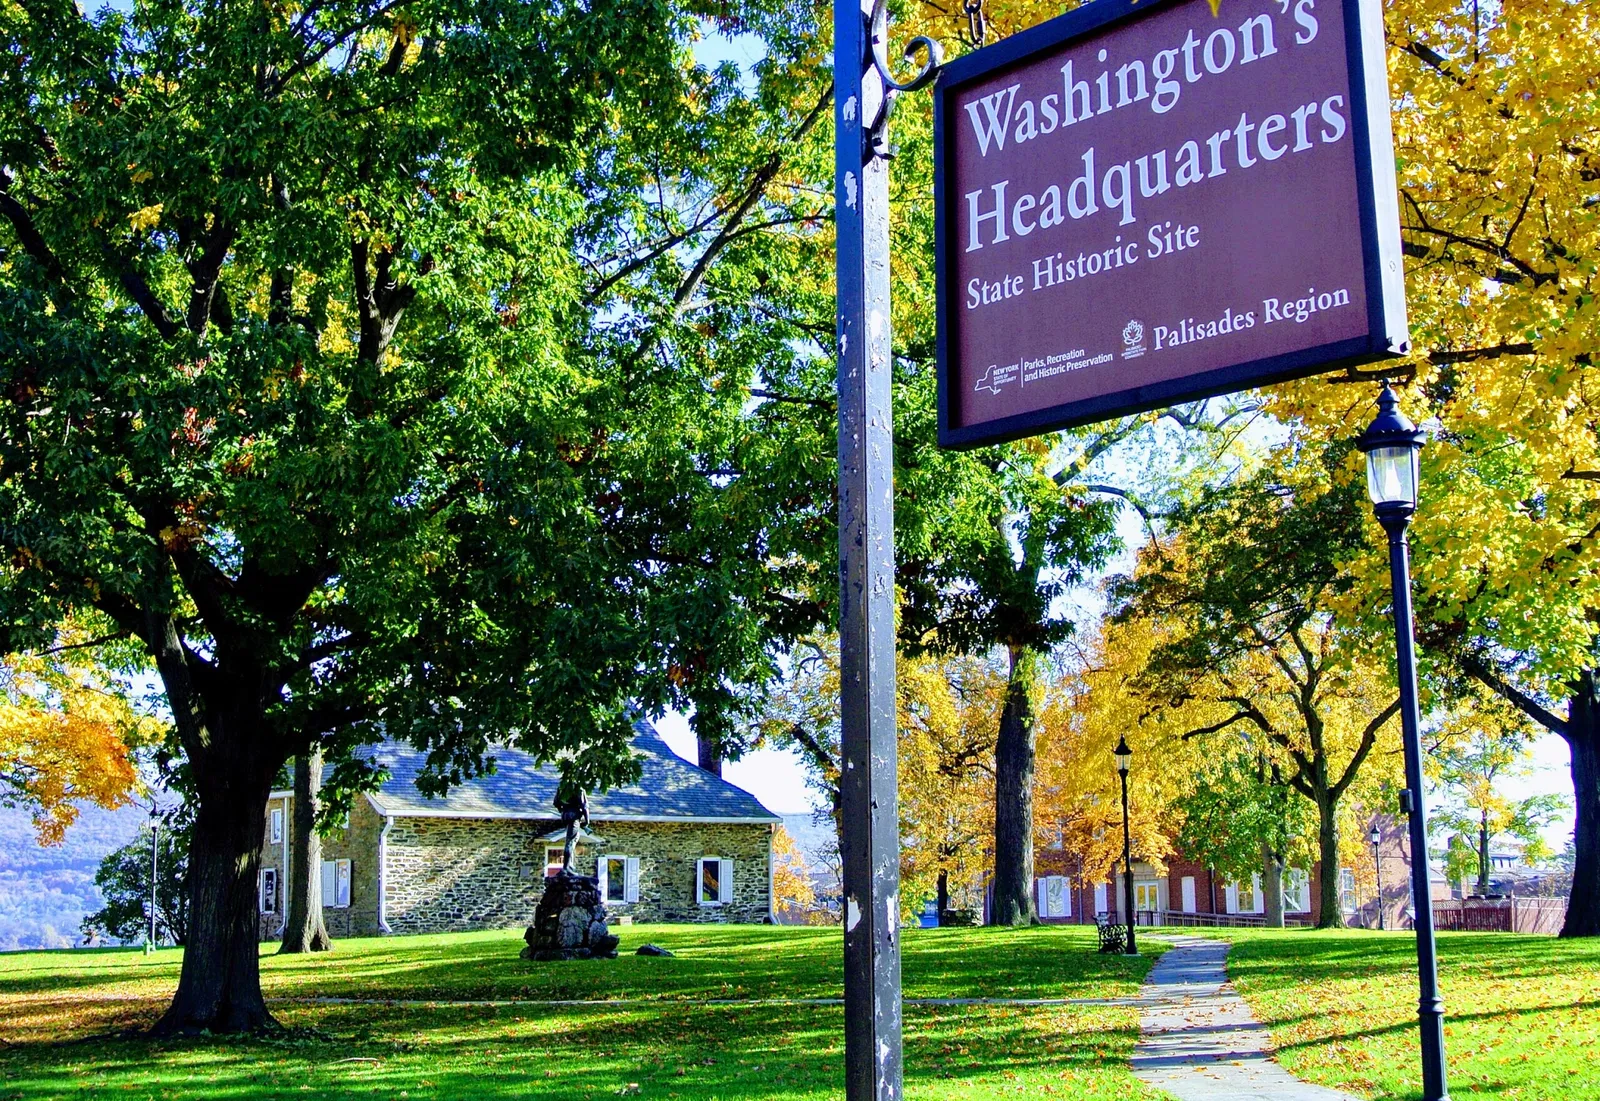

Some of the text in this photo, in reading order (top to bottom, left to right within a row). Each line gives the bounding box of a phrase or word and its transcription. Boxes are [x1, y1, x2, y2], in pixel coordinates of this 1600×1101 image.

[964, 0, 1319, 157] Washington's
[965, 95, 1346, 253] Headquarters
[967, 221, 1200, 310] State Historic Site
[1153, 288, 1350, 351] Palisades Region
[1024, 349, 1085, 371] Parks, Recreation
[1024, 370, 1039, 381] and
[1039, 364, 1066, 378] Historic
[1066, 353, 1113, 371] Preservation
